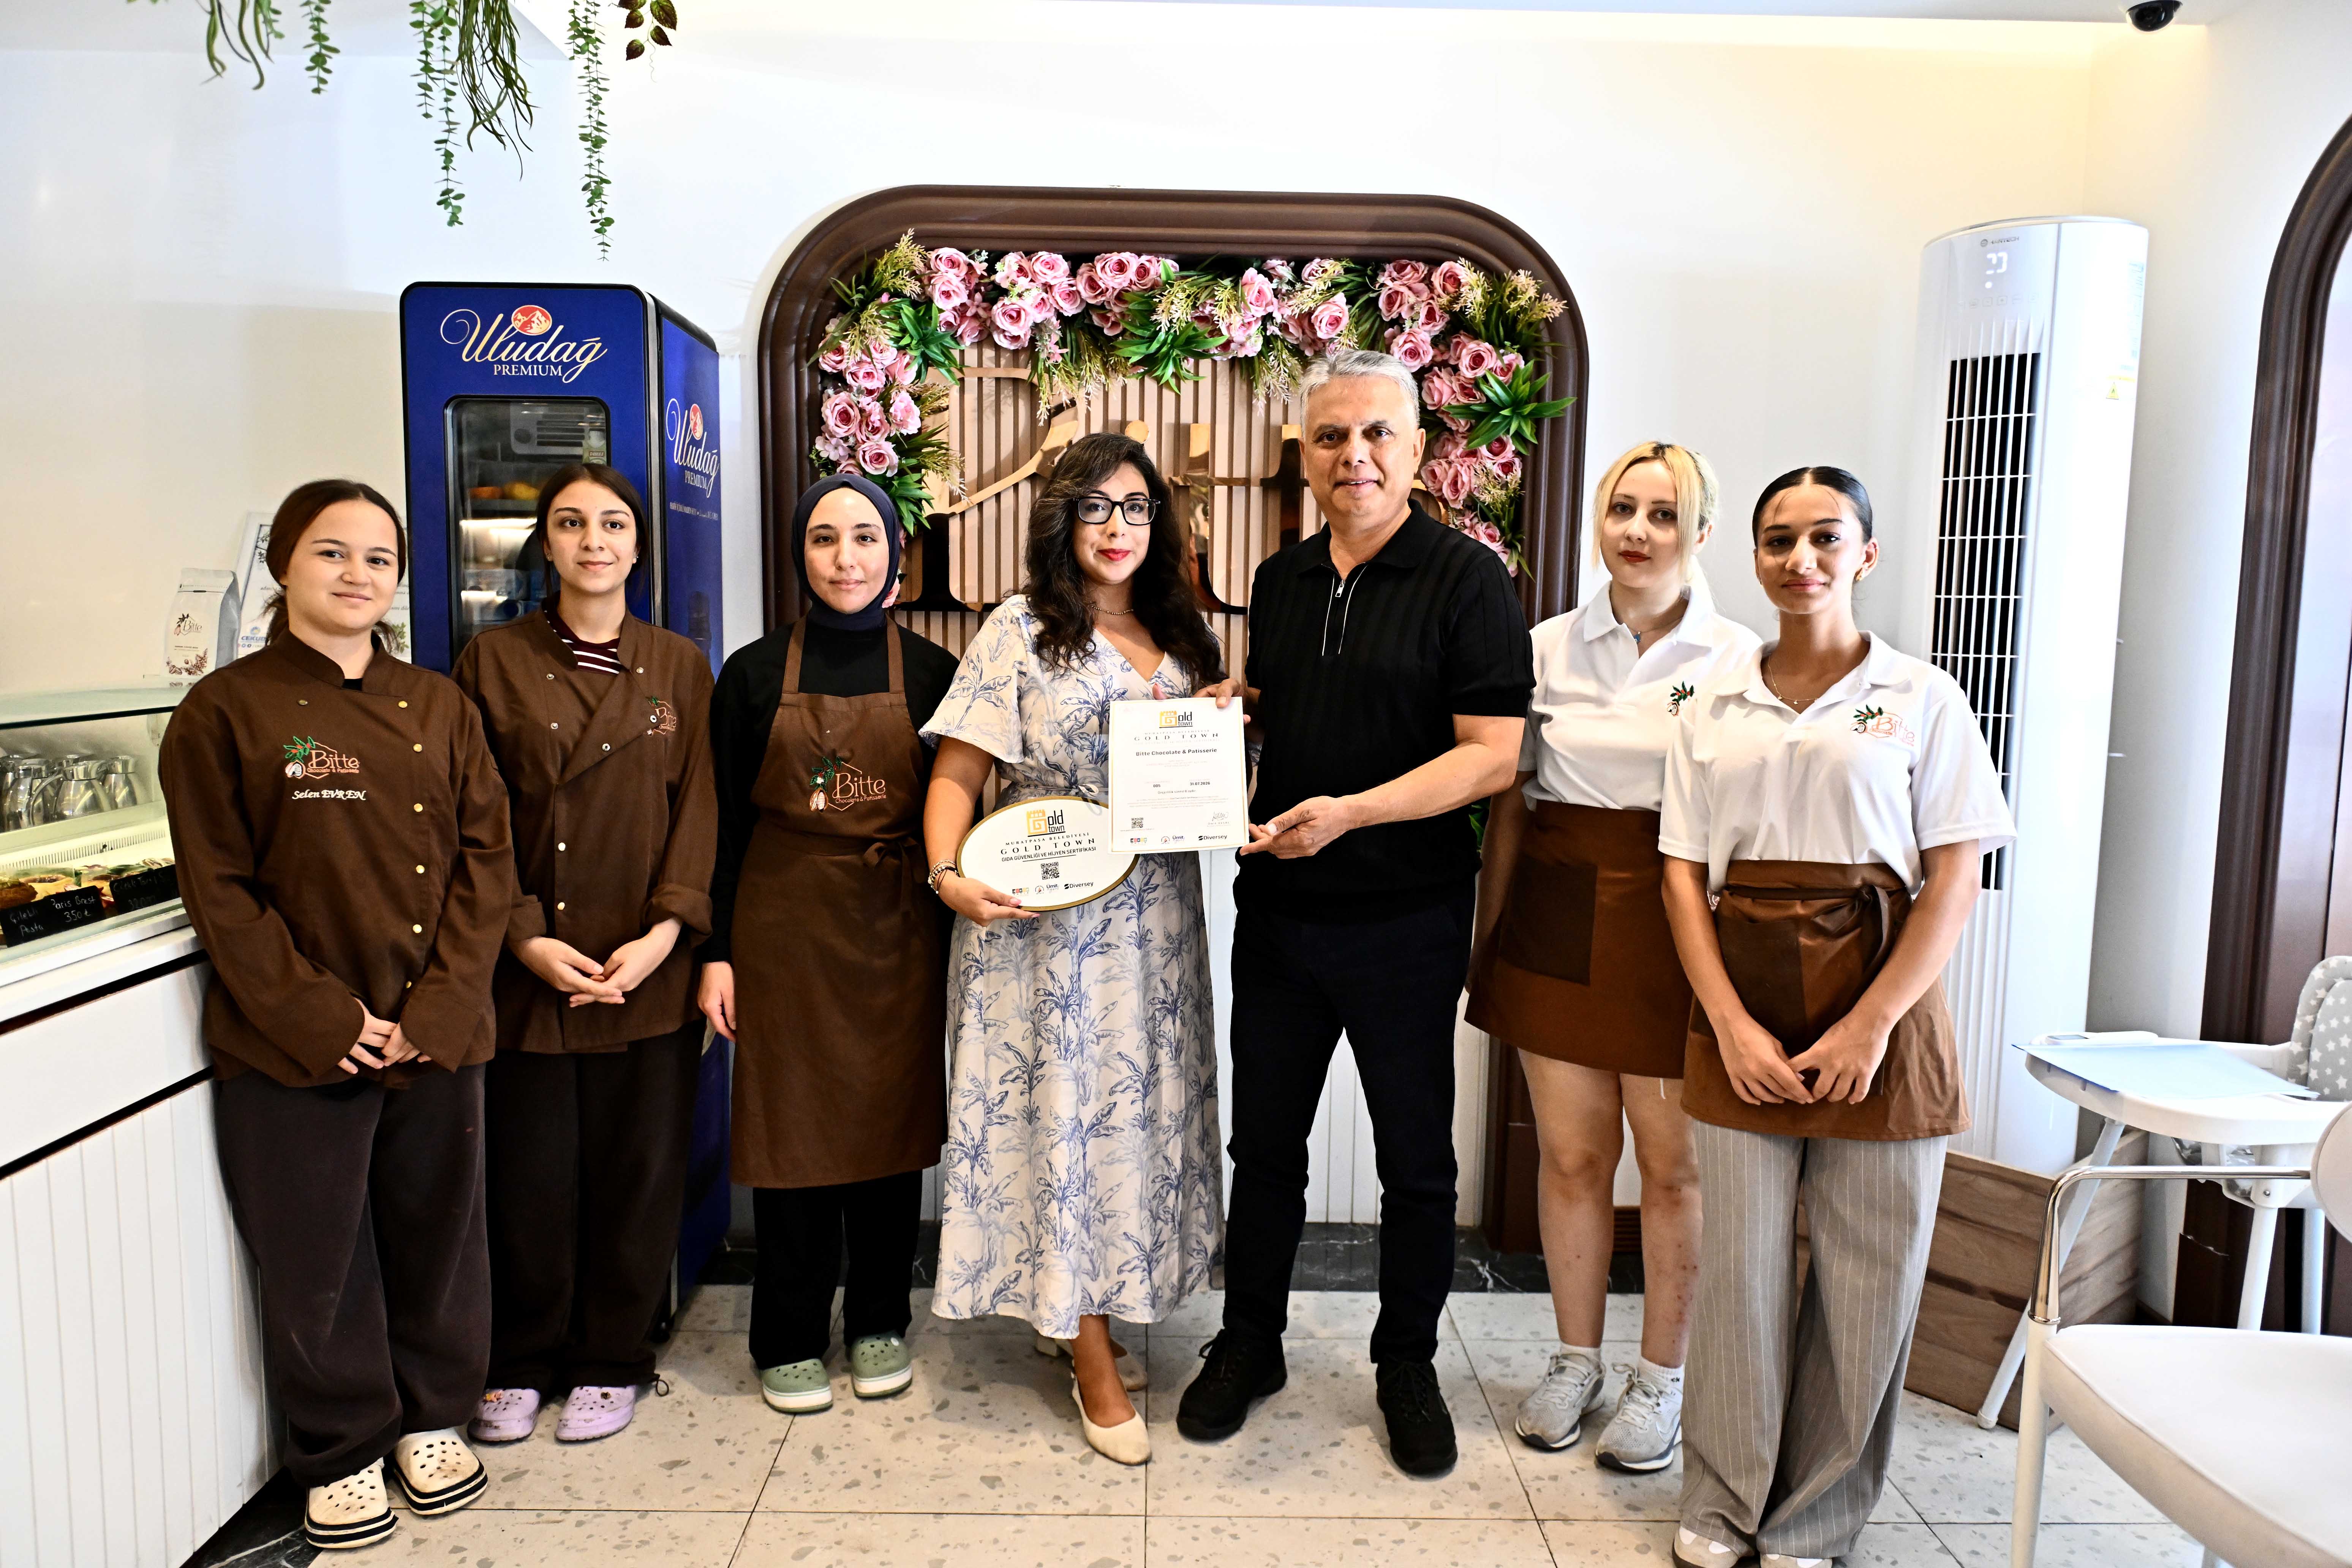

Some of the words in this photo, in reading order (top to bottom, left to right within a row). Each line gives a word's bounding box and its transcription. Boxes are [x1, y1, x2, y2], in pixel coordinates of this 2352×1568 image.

[440, 309, 608, 383] Uludağ
[494, 364, 562, 376] PREMIUM
[666, 398, 719, 498] Uludağ
[685, 470, 707, 490] PREMIUM
[308, 750, 359, 768] Bitte
[832, 773, 885, 798] Bitte
[292, 789, 320, 800] Selen
[321, 789, 367, 800] EVREN
[1049, 832, 1089, 841] BELEDİYESİ
[1001, 845, 1041, 855] GOLD
[1053, 838, 1095, 849] TOWN
[1014, 852, 1040, 860] GÜVENLİĞİ
[76, 895, 97, 905] Brest
